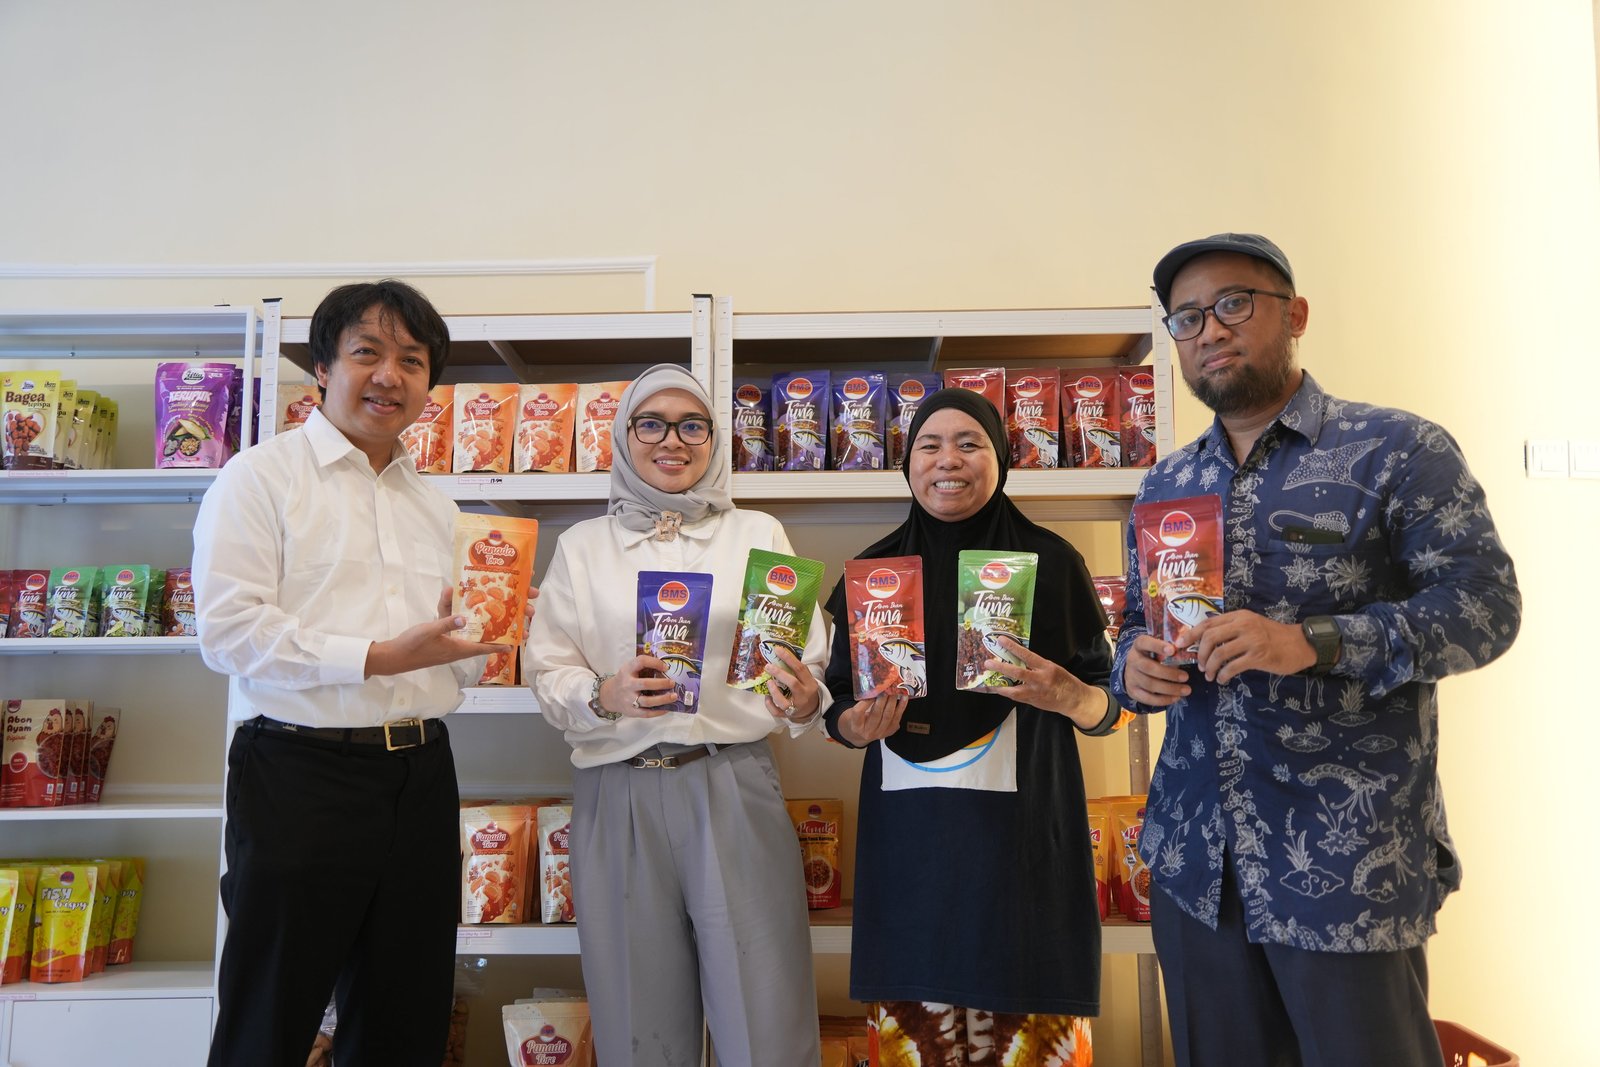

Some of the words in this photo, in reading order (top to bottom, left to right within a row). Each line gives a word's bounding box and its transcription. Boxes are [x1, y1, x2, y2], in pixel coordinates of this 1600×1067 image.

[847, 383, 867, 391] BMS
[5, 391, 45, 406] Bagea
[785, 400, 814, 423] Tuna
[842, 400, 871, 423] Tuna
[1013, 398, 1043, 423] Tuna
[1073, 398, 1104, 422] Tuna
[1128, 395, 1156, 420] Tuna
[735, 407, 764, 429] Tuna
[1163, 520, 1193, 533] BMS
[475, 541, 515, 556] Panada
[485, 554, 504, 565] Tore
[1155, 549, 1198, 584] Tuna
[770, 571, 795, 584] BMS
[869, 576, 897, 586] BMS
[661, 589, 687, 599] BMS
[754, 594, 793, 626] Tuna
[974, 590, 1014, 620] Tuna
[863, 600, 903, 630] Tuna
[653, 612, 689, 642] Tuna
[8, 716, 32, 724] Abon
[7, 725, 32, 733] Ayam
[475, 832, 506, 842] Panada
[553, 832, 568, 842] Pan
[54, 899, 87, 911] Crispy
[526, 1040, 567, 1054] Panada
[536, 1053, 556, 1064] Tore
